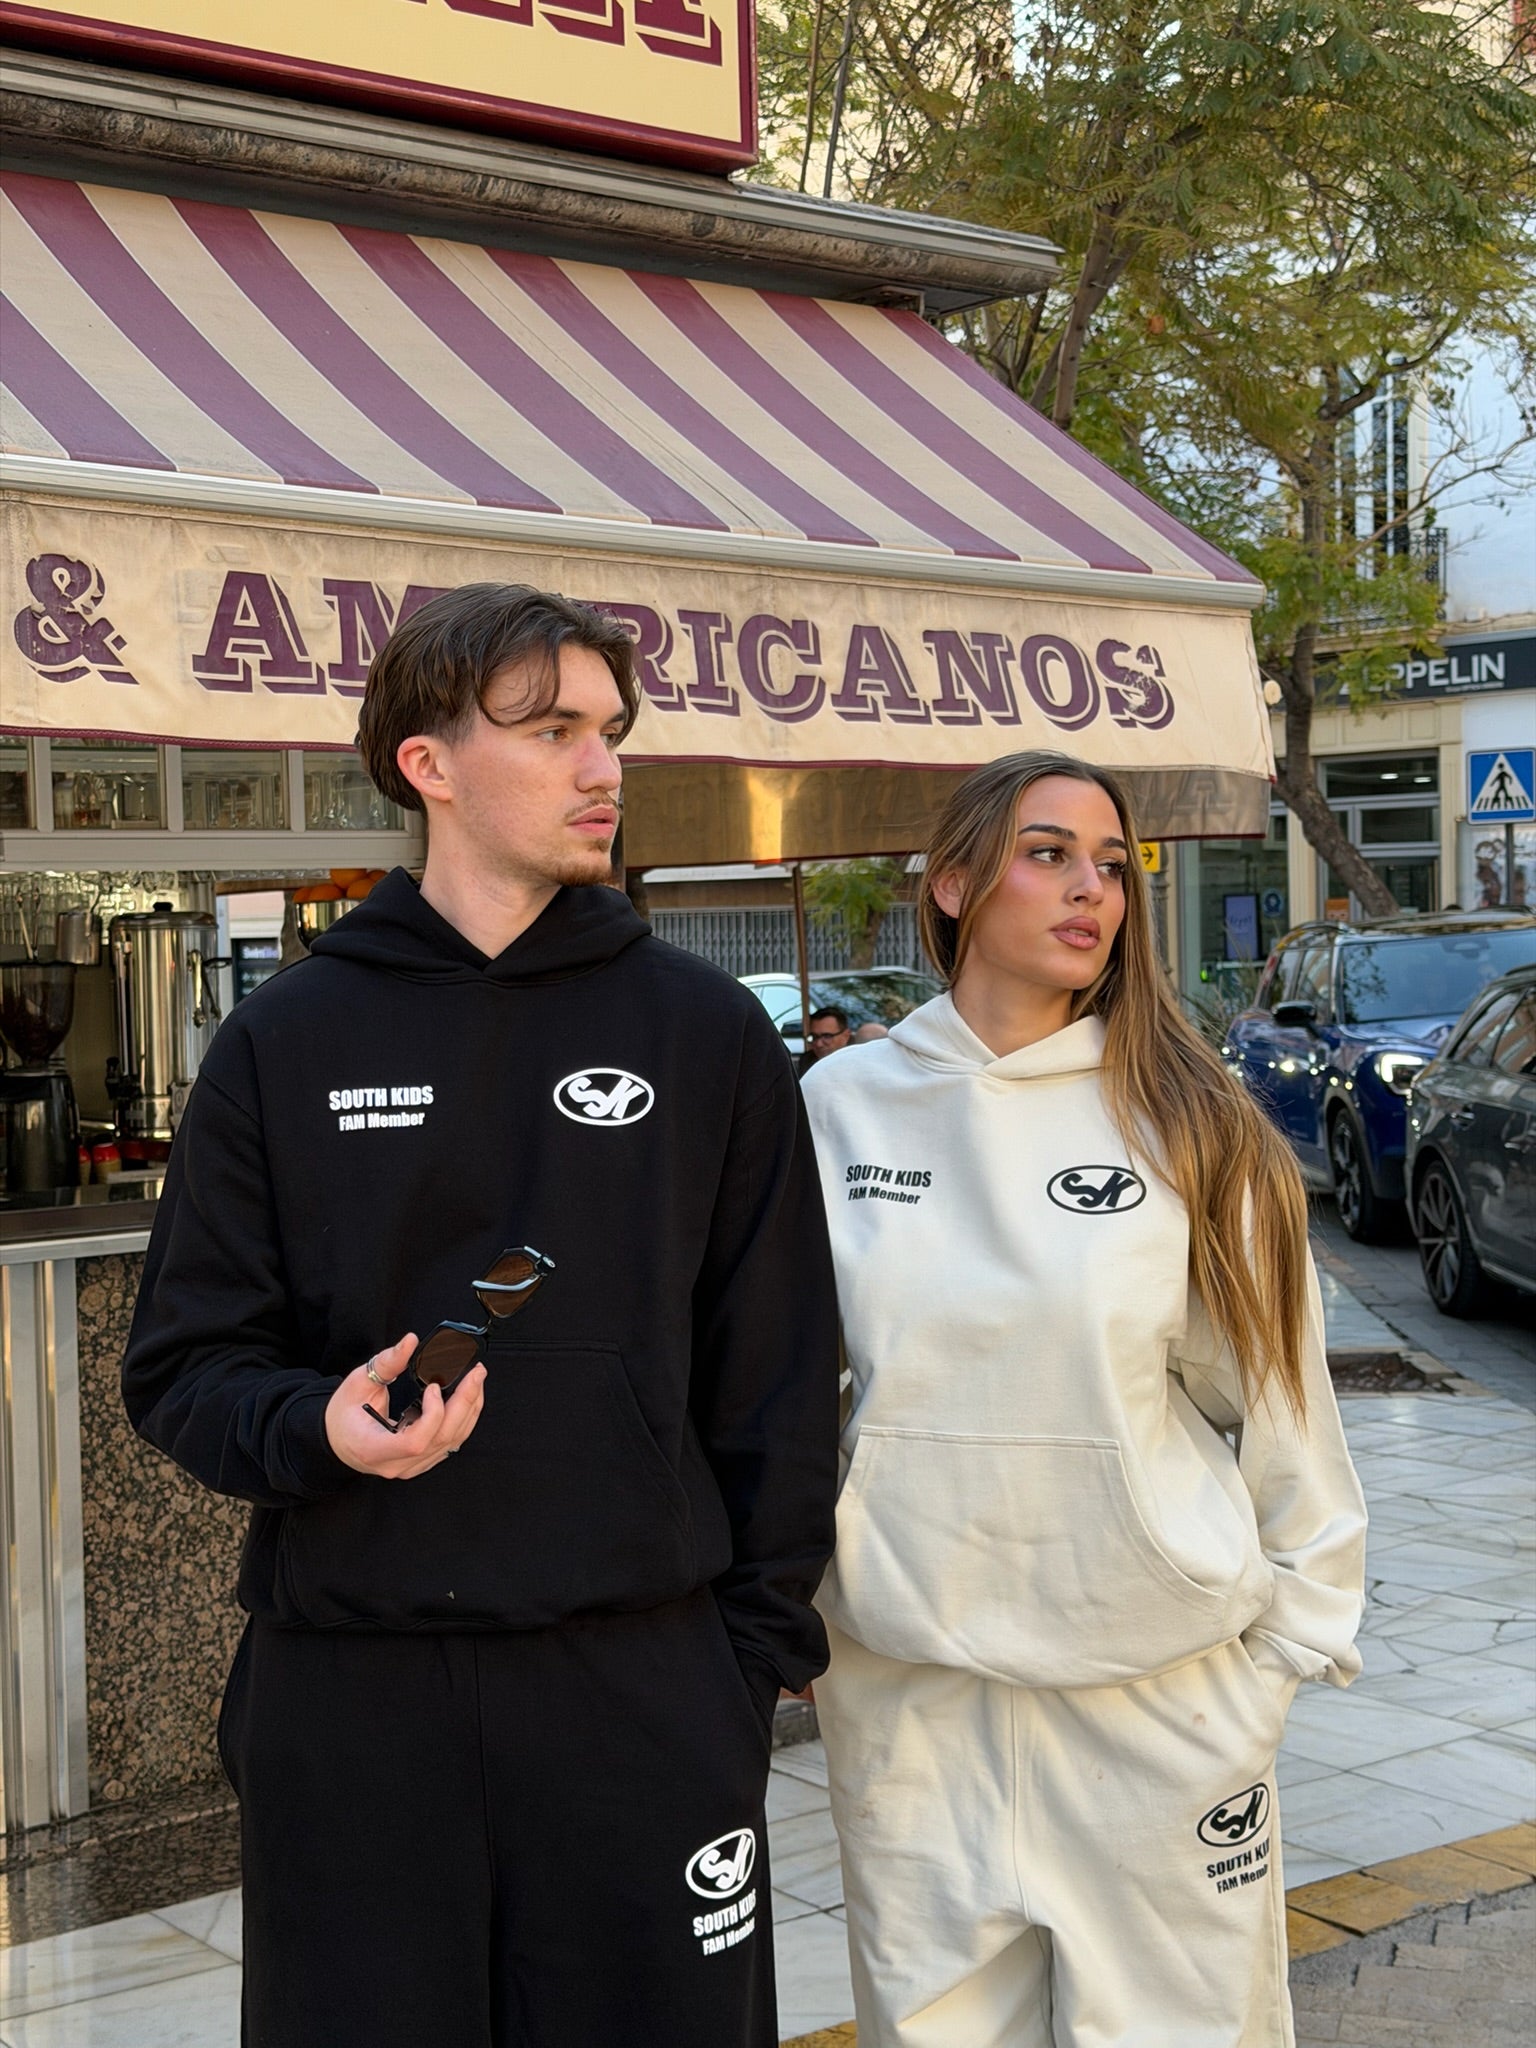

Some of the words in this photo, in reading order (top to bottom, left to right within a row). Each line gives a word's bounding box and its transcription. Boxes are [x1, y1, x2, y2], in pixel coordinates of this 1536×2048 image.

[14, 553, 140, 685] &
[328, 1088, 388, 1111] SOUTH
[390, 1085, 435, 1106] KIDS
[338, 1113, 366, 1132] FAM
[366, 1111, 425, 1129] Member
[845, 1164, 894, 1184] SOUTH
[894, 1169, 932, 1188] KIDS
[847, 1185, 868, 1201] FAM
[867, 1185, 921, 1205] Member
[1206, 1850, 1253, 1879] SOUTH
[1216, 1875, 1239, 1895] FAM
[692, 1903, 739, 1937] SOUTH
[702, 1934, 726, 1957] FAM
